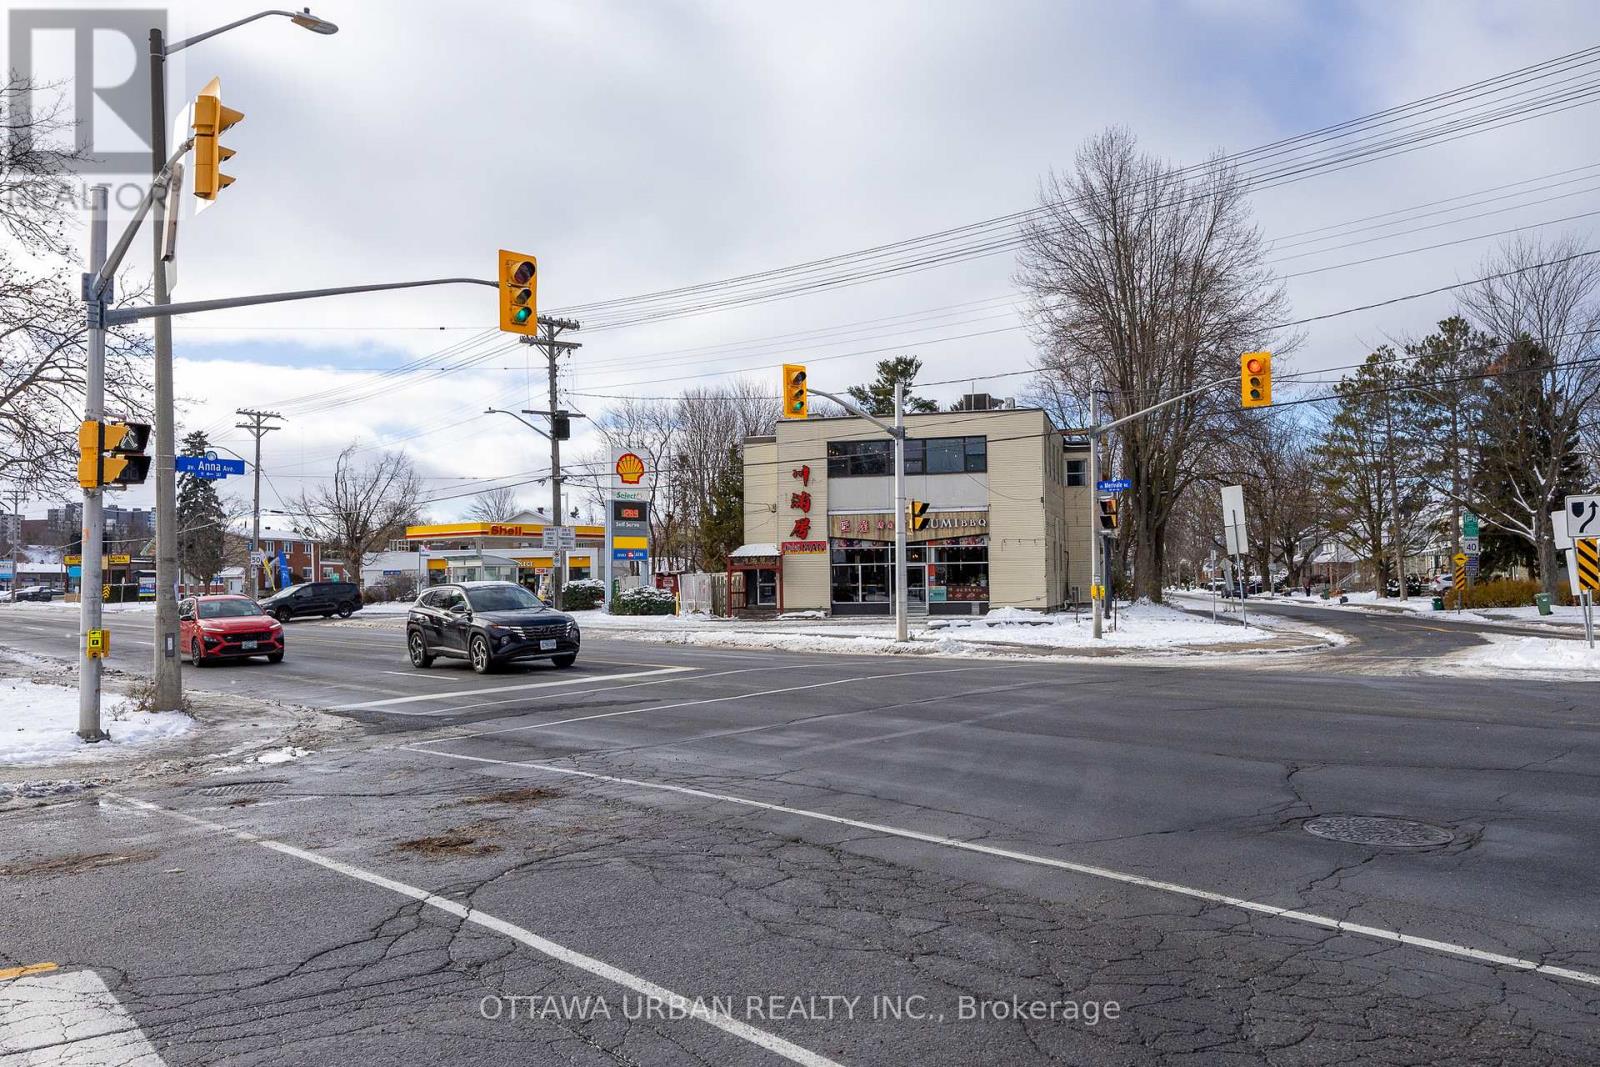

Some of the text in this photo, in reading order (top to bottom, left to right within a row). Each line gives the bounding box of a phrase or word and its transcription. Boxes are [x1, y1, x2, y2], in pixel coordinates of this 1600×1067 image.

[198, 460, 221, 471] Anna
[961, 518, 986, 528] BBQ
[491, 526, 522, 536] Shell
[1466, 543, 1476, 551] 40
[251, 556, 260, 564] 50
